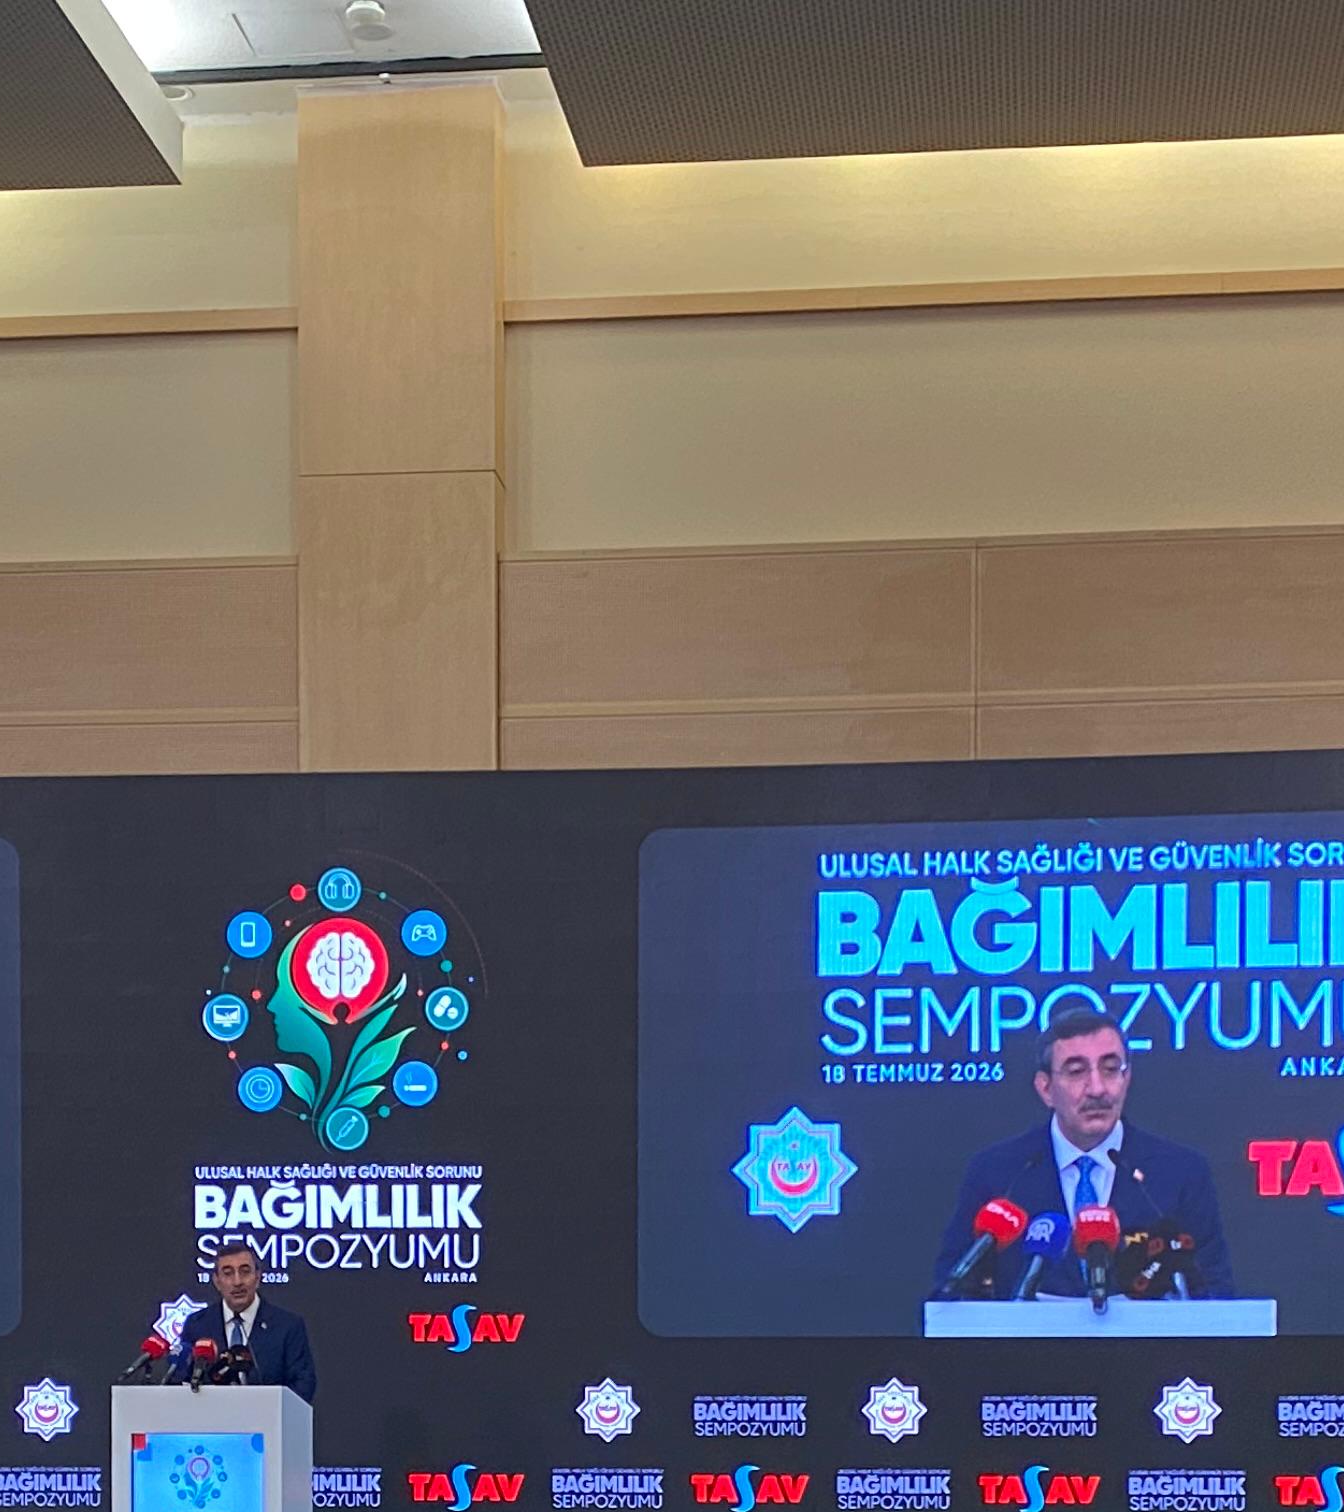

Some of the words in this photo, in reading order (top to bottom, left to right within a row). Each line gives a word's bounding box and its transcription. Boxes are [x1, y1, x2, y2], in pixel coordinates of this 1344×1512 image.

[821, 853, 918, 877] ULUSAL
[924, 851, 990, 875] HALK
[997, 845, 1102, 877] SAĞLIĞI
[1109, 847, 1143, 871] VE
[1150, 838, 1281, 870] GÜVENLİK
[823, 1065, 845, 1083] 18
[853, 1063, 943, 1082] TEMMUZ
[951, 1063, 1004, 1081] 2026
[195, 1166, 245, 1179] ULUSAL
[247, 1166, 281, 1178] HALK
[284, 1164, 336, 1178] SAĞLIĞI
[339, 1166, 356, 1178] VE
[358, 1164, 423, 1178] GÜVENLİK
[426, 1165, 482, 1178] SORUNU
[195, 1181, 482, 1229] BAĞIMLILIK
[262, 1273, 289, 1282] 2026
[424, 1272, 477, 1282] ANKARA
[409, 1305, 525, 1352] TASAV
[694, 1402, 806, 1421] BAĞIMLILIK
[982, 1401, 1097, 1421] BAĞIMLILIK
[695, 1422, 805, 1436] SEMPOZYUMU
[983, 1422, 1096, 1436] SEMPOZYUMU
[313, 1474, 382, 1492] IMLILIK
[409, 1465, 524, 1511] TASAV
[552, 1474, 663, 1493] BAĞIMLILIK
[691, 1466, 809, 1512] TASAV
[837, 1475, 950, 1494] BAĞIMLILIK
[979, 1466, 1100, 1512] TASAV
[1129, 1475, 1246, 1495] BAĞIMLILIK
[313, 1493, 381, 1507] OZYUMU
[553, 1494, 662, 1508] SEMPOZYUMU
[838, 1496, 950, 1509] SEMPOZYUMU
[1130, 1497, 1245, 1511] SEMPOZYUMU
